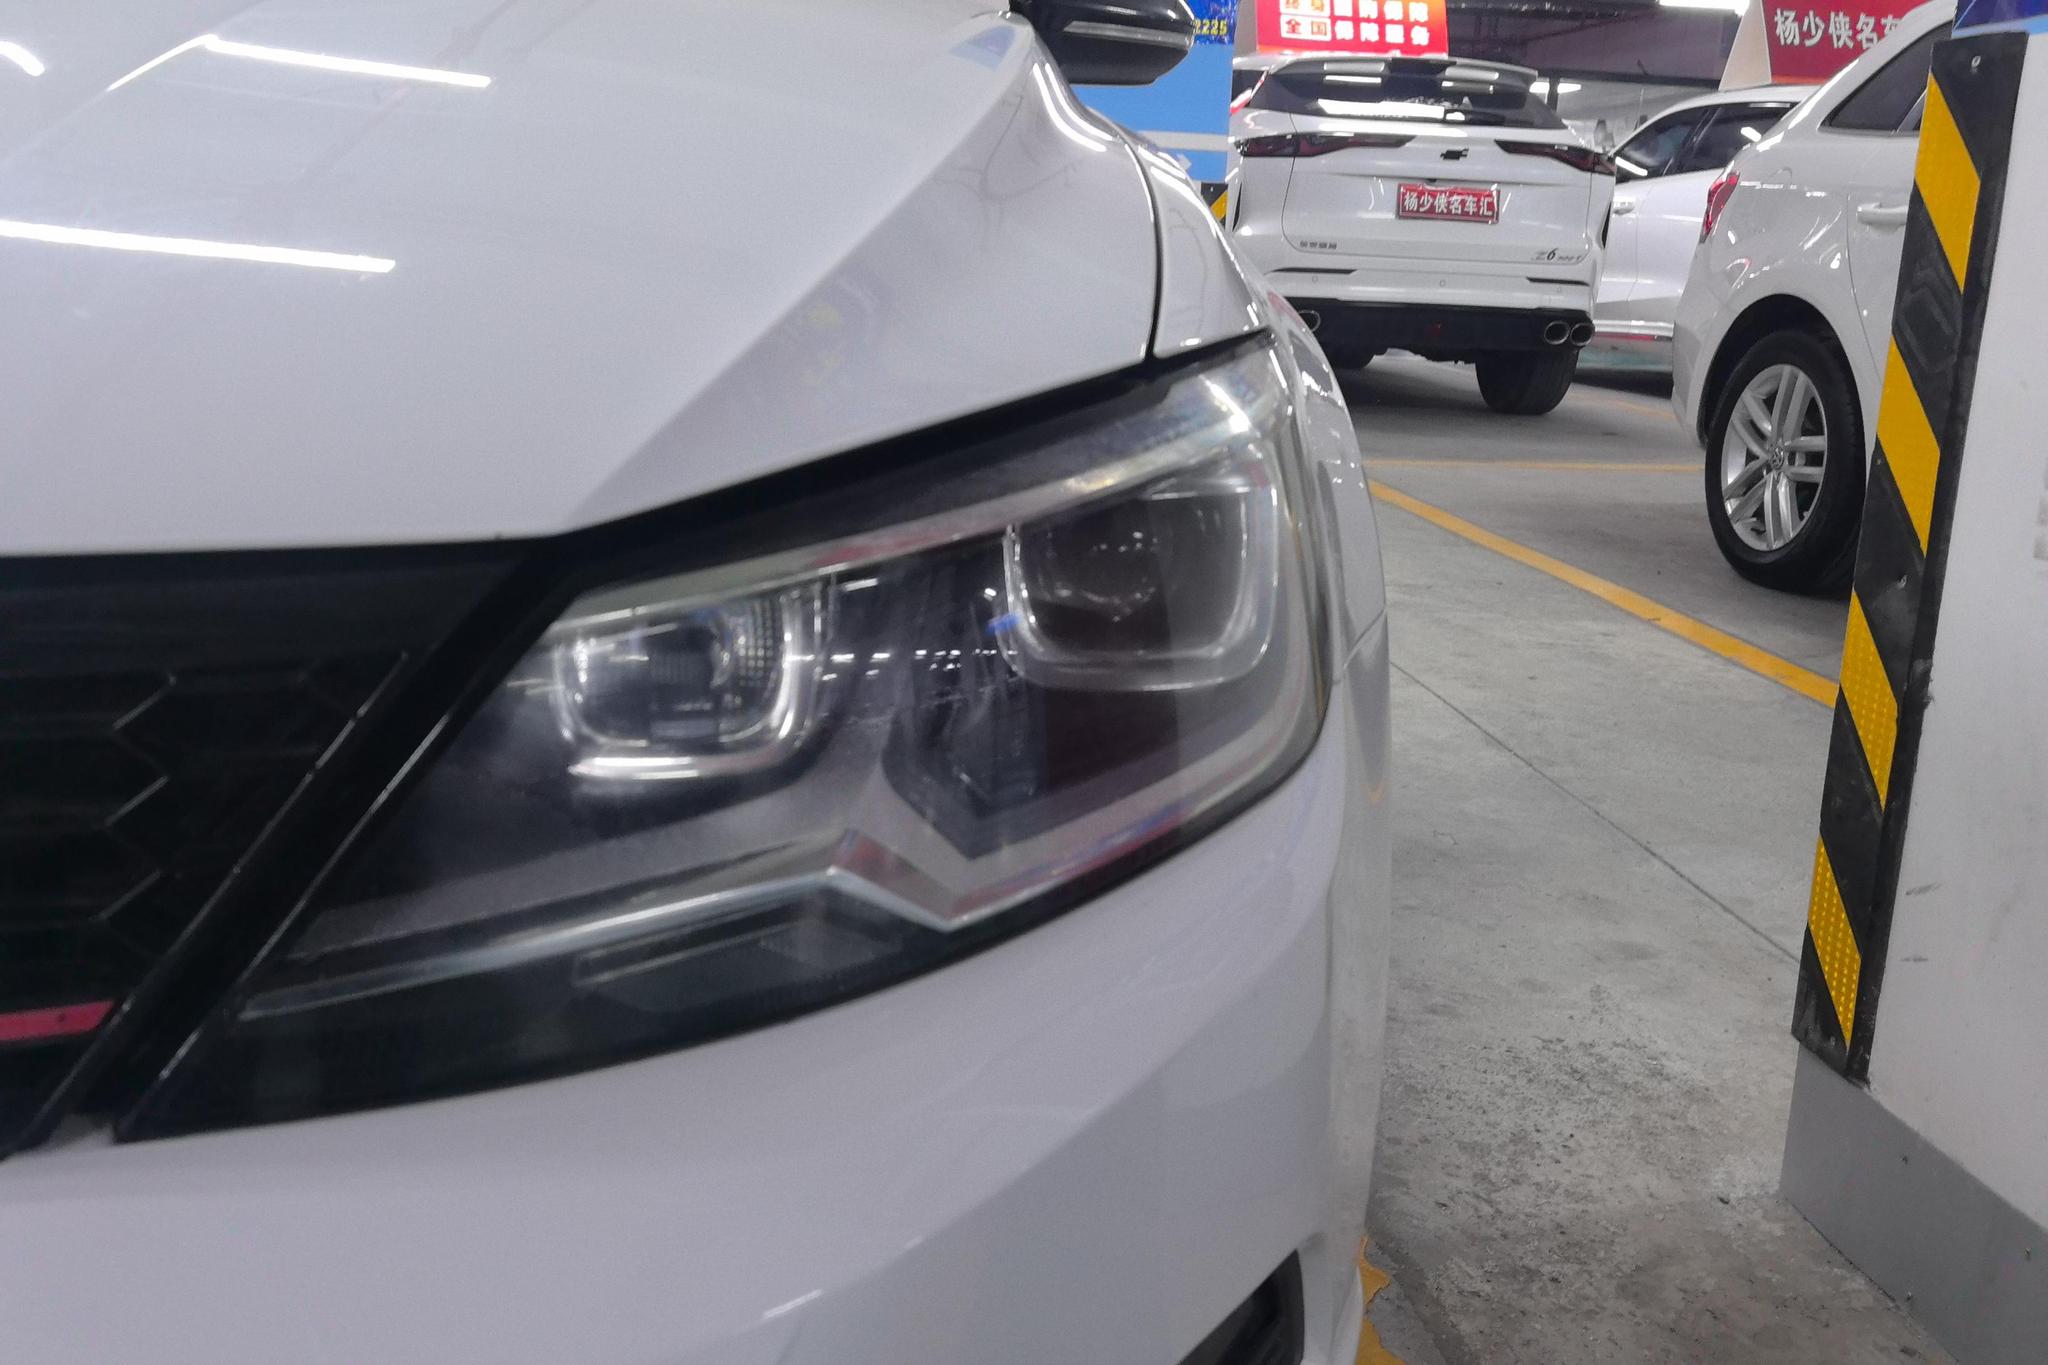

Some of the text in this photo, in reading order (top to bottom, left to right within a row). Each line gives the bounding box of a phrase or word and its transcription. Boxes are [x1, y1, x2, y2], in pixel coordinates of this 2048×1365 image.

[1403, 191, 1493, 216] 杨少侠名车汇
